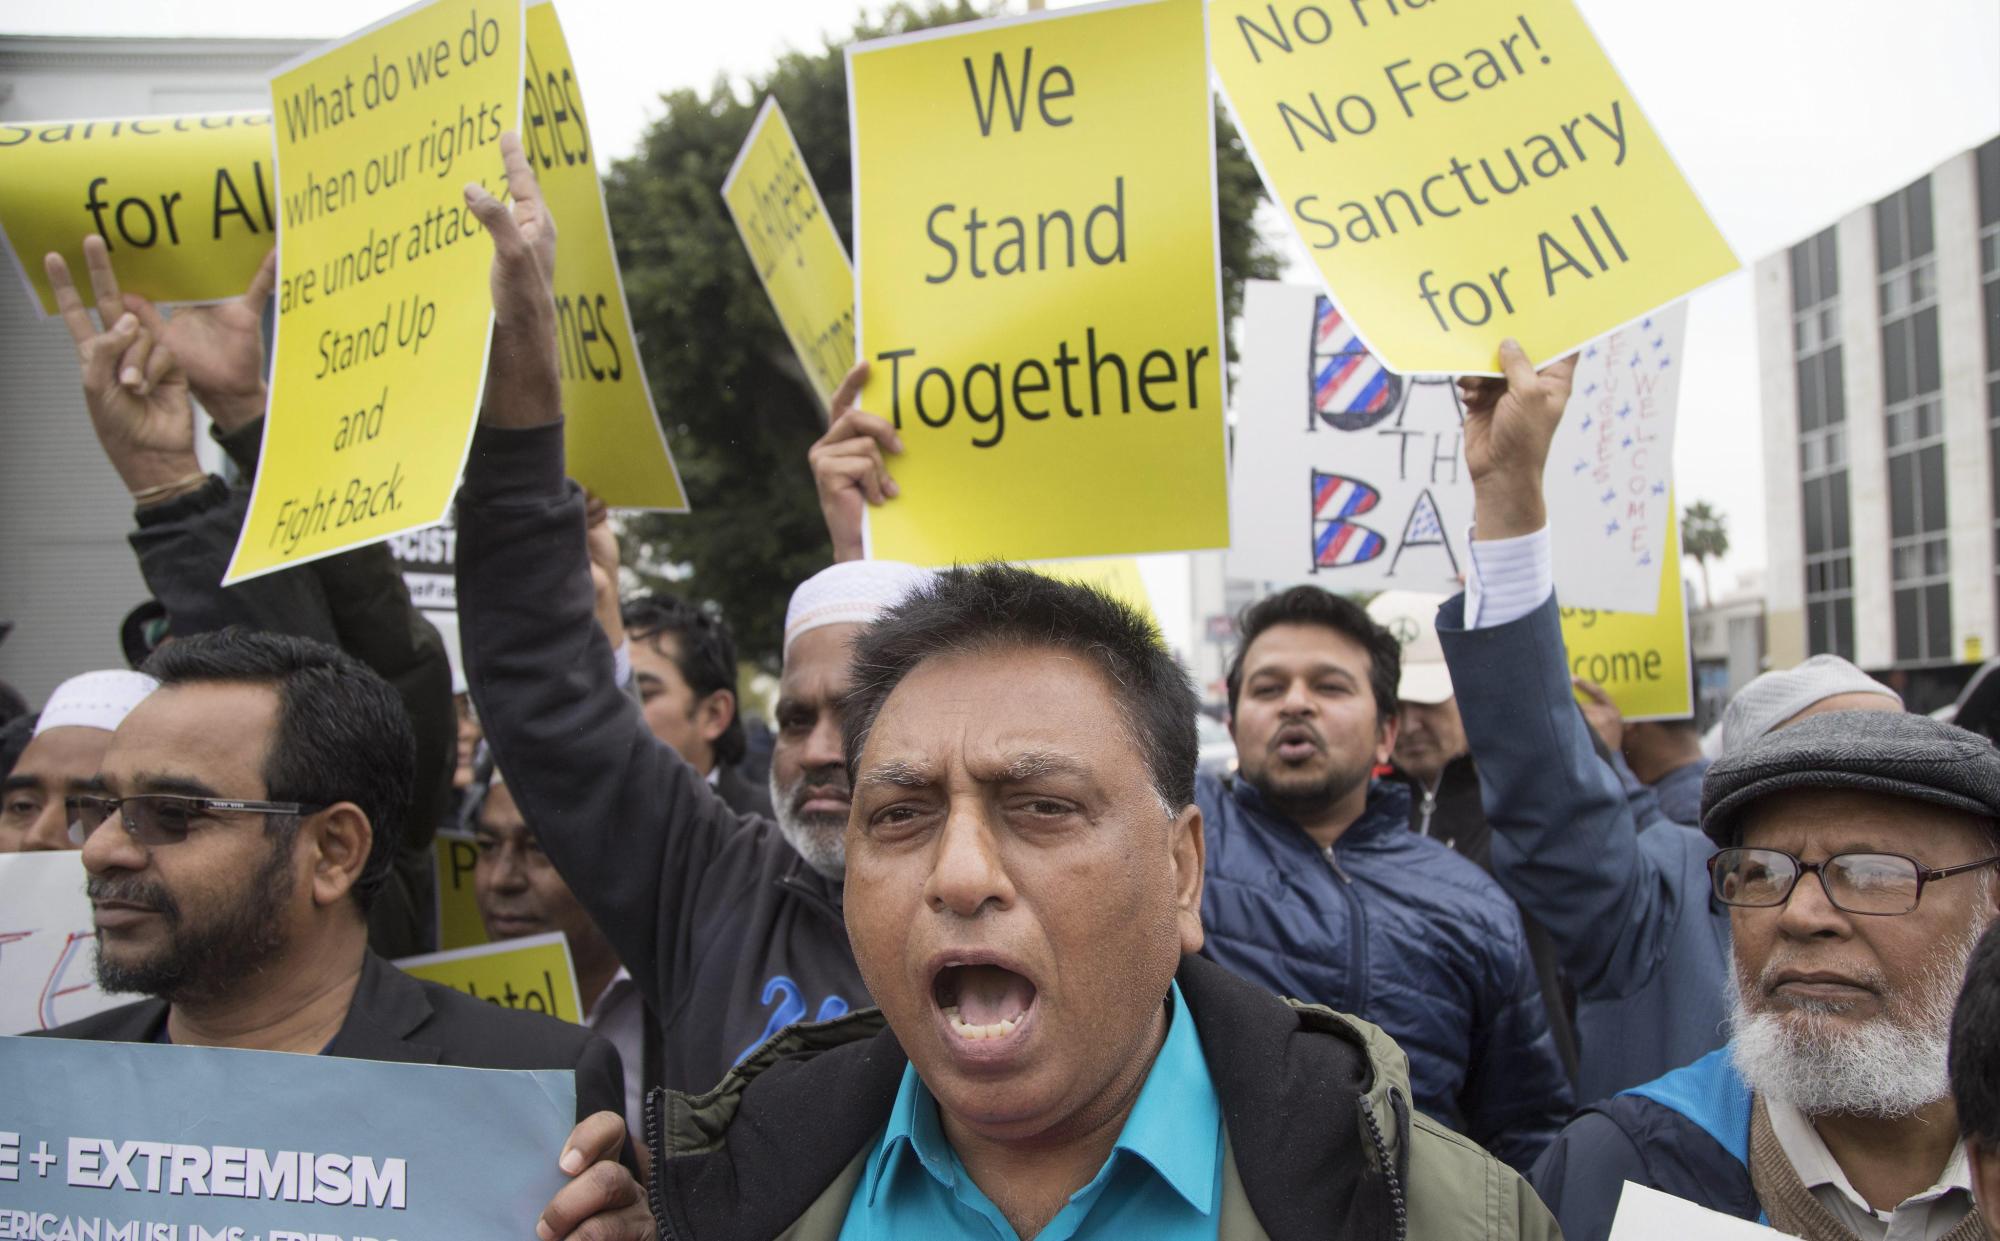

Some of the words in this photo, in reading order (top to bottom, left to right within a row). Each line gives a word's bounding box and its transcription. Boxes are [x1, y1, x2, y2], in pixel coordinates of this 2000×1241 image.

[284, 73, 356, 144] What
[363, 54, 400, 110] do
[407, 40, 450, 90] we
[460, 9, 499, 66] do
[1235, 3, 1333, 64] No
[1276, 91, 1377, 153] No
[1383, 15, 1551, 119] Fear!
[963, 46, 1076, 138] We
[85, 176, 182, 252] for
[286, 171, 357, 228] when
[364, 143, 411, 195] our
[418, 101, 503, 178] rights
[1294, 100, 1628, 249] Sanctuary
[279, 268, 317, 314] are
[323, 228, 401, 296] under
[924, 176, 1128, 284] Stand
[1418, 269, 1516, 332] for
[1537, 204, 1630, 297] All
[316, 303, 391, 379] Stand
[397, 294, 436, 354] Up
[334, 385, 388, 451] and
[877, 327, 1209, 448] Together
[269, 487, 337, 556] Fight
[336, 461, 405, 528] Back.
[1627, 372, 1659, 553] WELCOME
[67, 1136, 407, 1209] EXTREMISM
